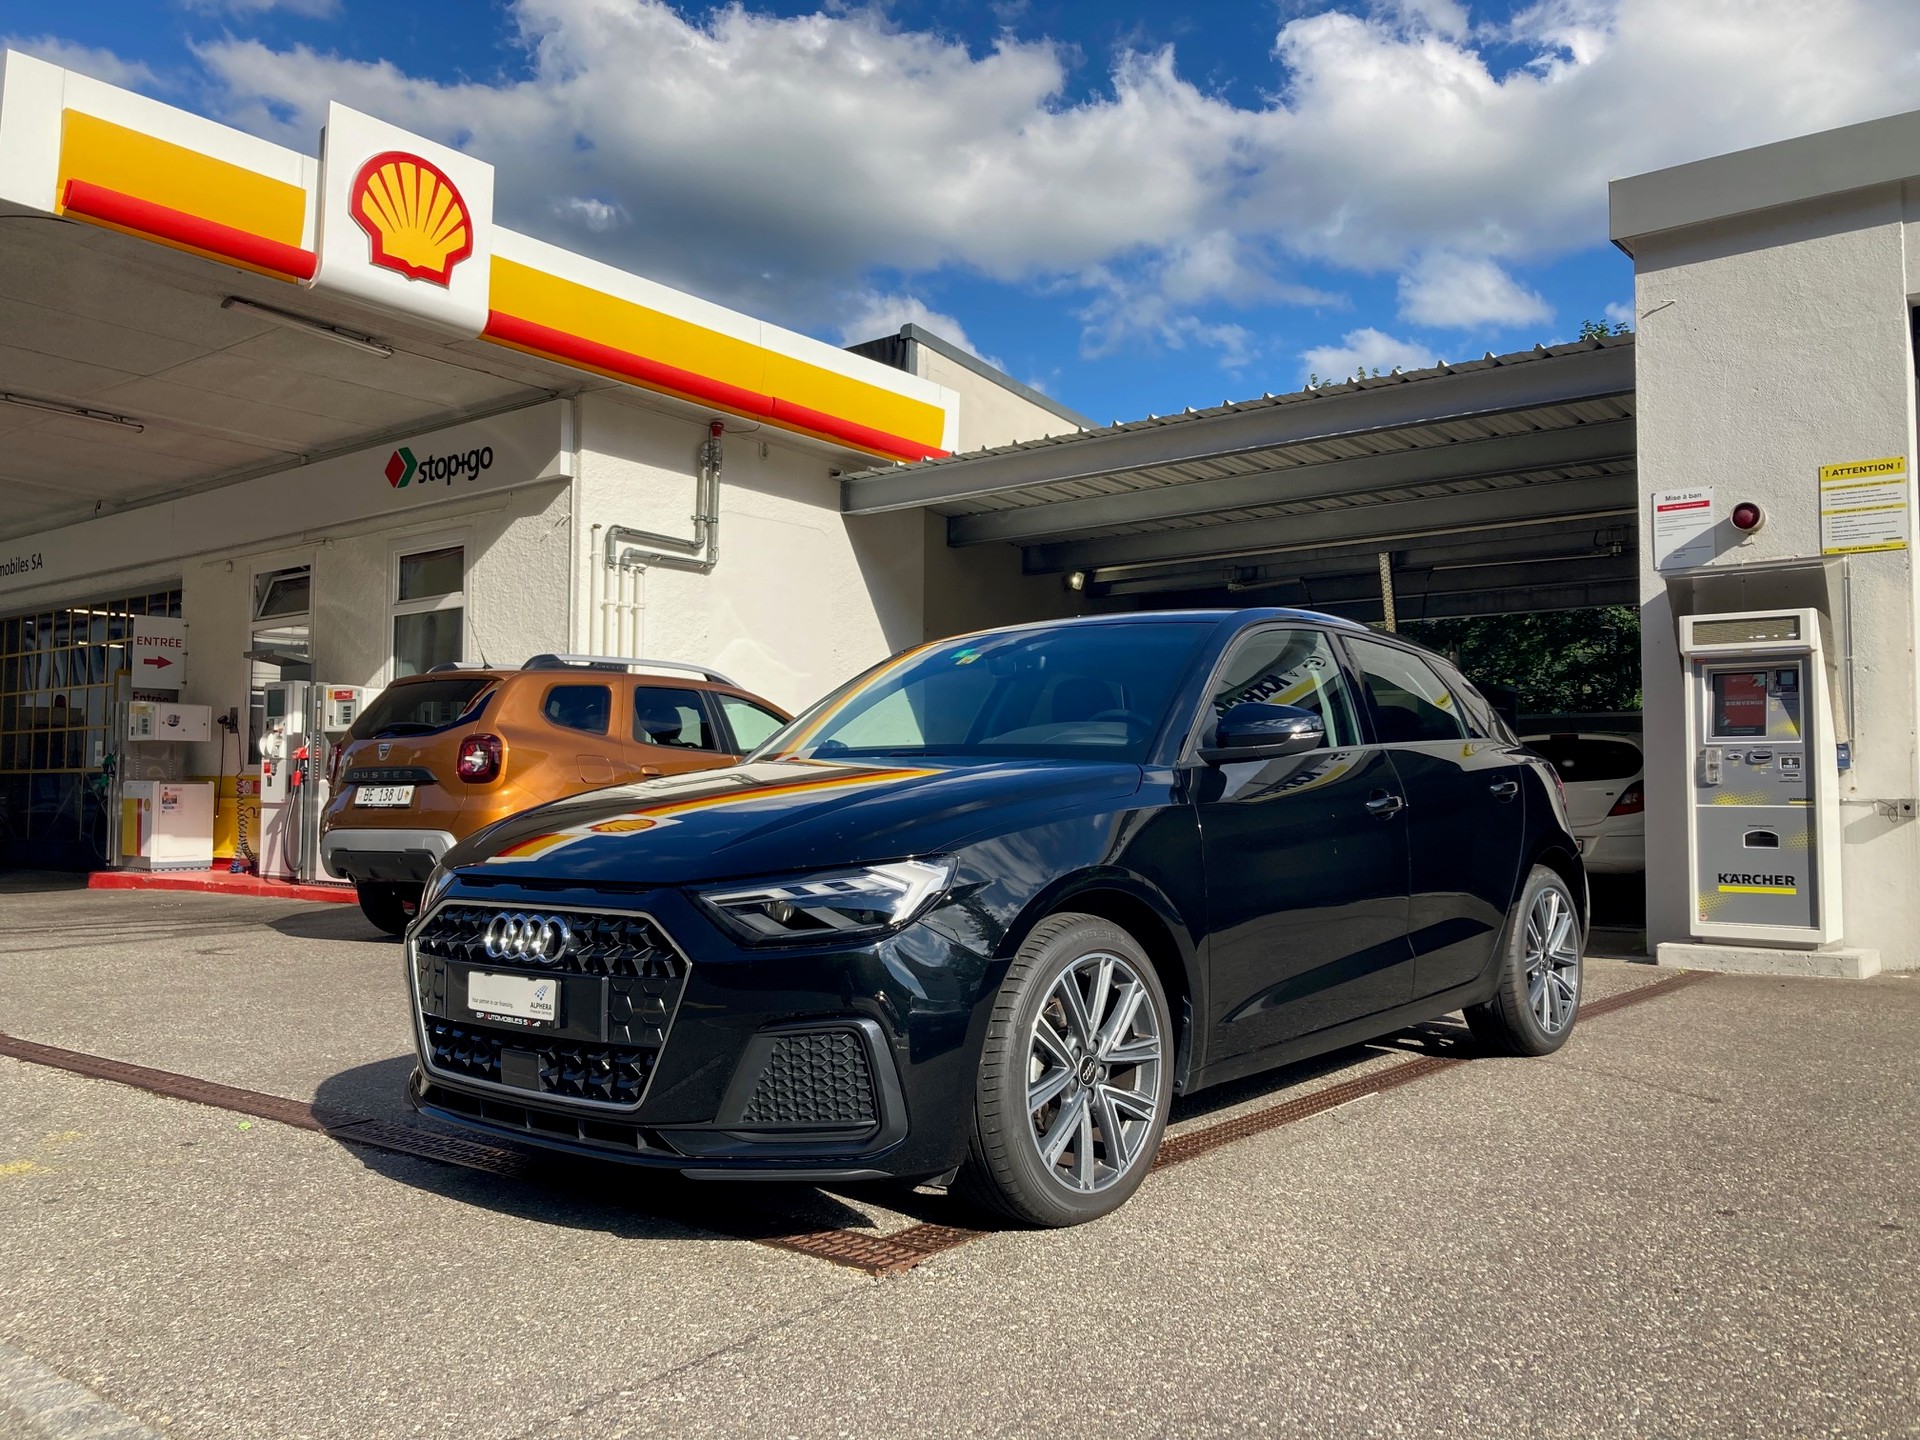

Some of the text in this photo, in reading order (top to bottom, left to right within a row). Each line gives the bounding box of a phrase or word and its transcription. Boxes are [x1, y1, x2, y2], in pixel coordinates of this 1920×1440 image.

[418, 446, 494, 486] stop+go
[1831, 463, 1894, 476] ATTENTION
[31, 553, 43, 570] SA
[136, 635, 182, 648] ENTRÉE
[353, 771, 413, 779] DUSTER
[363, 788, 404, 802] BE 138 U
[1718, 873, 1796, 886] KÄRCHER
[530, 1001, 552, 1010] ALPHERA
